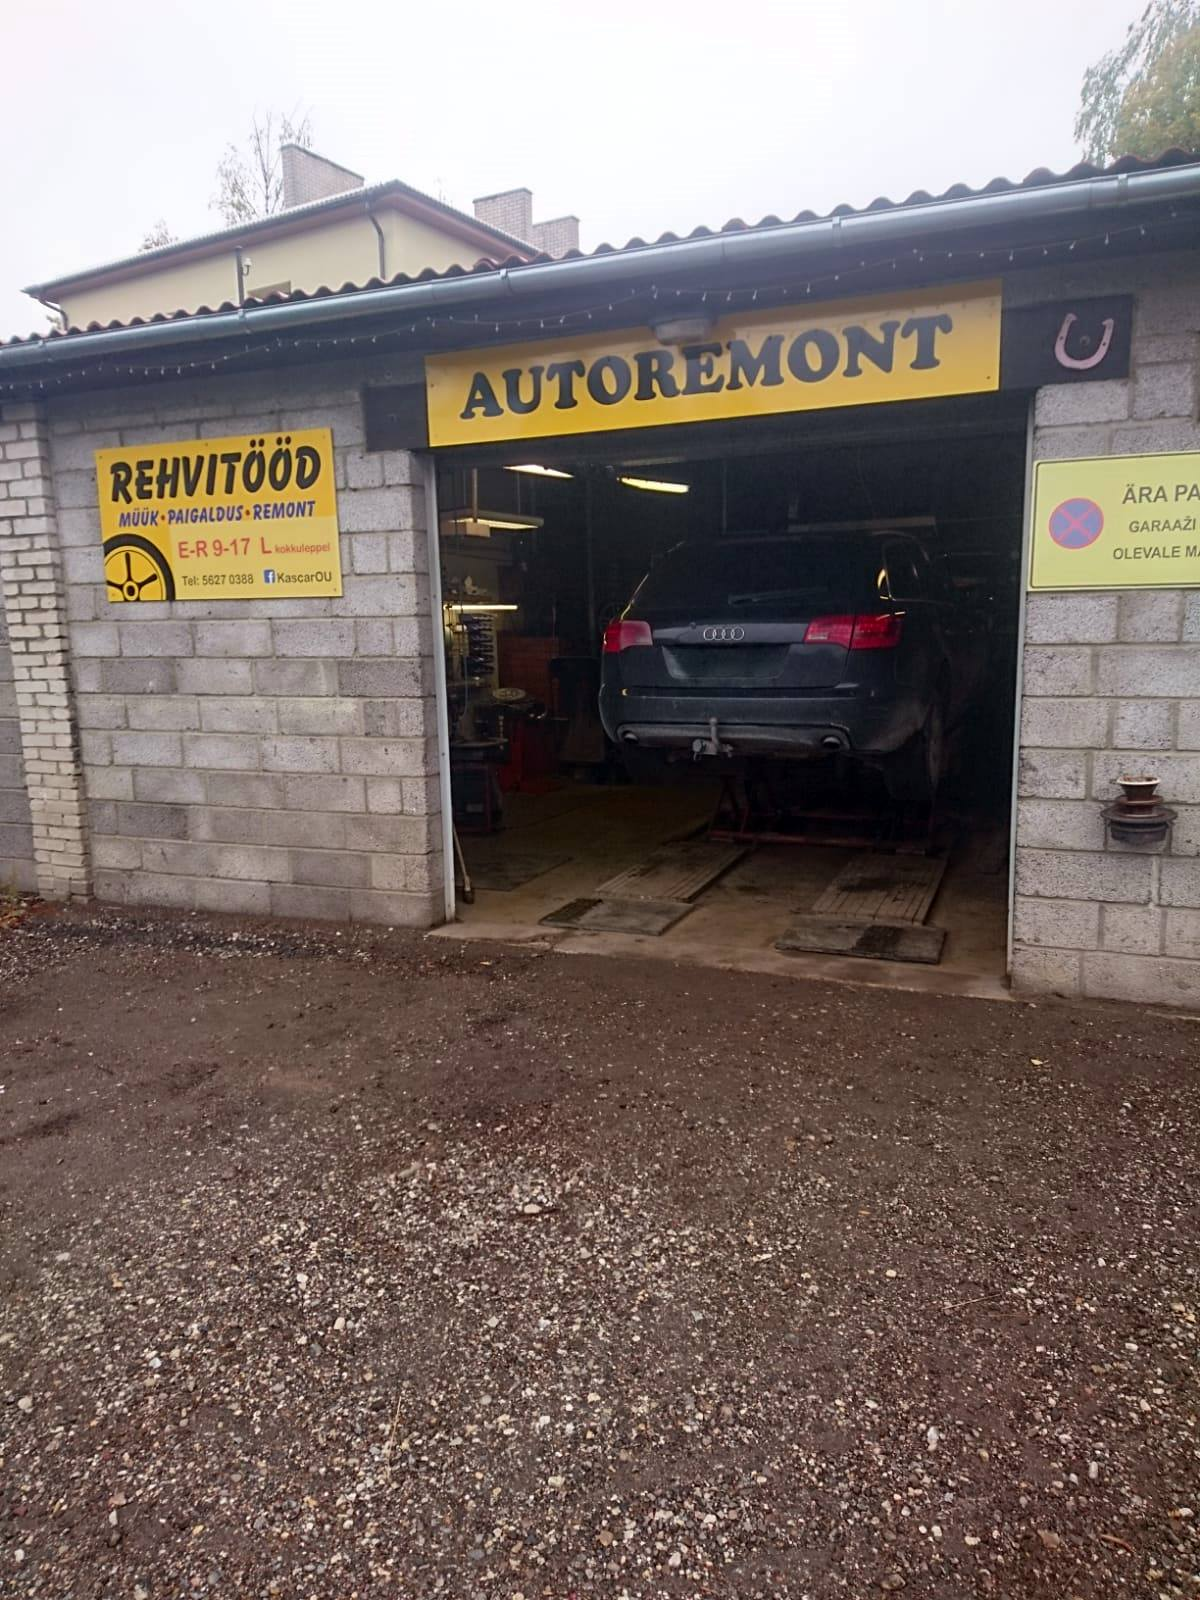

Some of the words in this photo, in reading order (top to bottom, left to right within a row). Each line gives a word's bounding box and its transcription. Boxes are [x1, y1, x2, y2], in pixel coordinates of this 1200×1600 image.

[460, 313, 953, 419] AUTOREMONT
[110, 436, 321, 504] REHVITÖÖD
[1122, 484, 1168, 504] ÄRA
[119, 508, 159, 527] MÜÜK
[168, 505, 244, 525] PAIGALDUS
[253, 500, 316, 520] REMONT
[1129, 516, 1196, 533] GARAAŽI
[178, 540, 208, 559] E-R
[213, 538, 251, 557] 9-17
[260, 537, 272, 554] L
[275, 542, 330, 556] kokkuleppel
[1113, 545, 1181, 560] OLEVALE
[1185, 545, 1200, 558] M
[182, 576, 199, 587] Tel:
[202, 575, 226, 586] 5627
[229, 574, 254, 585] 0388
[277, 571, 332, 583] KascarOU
